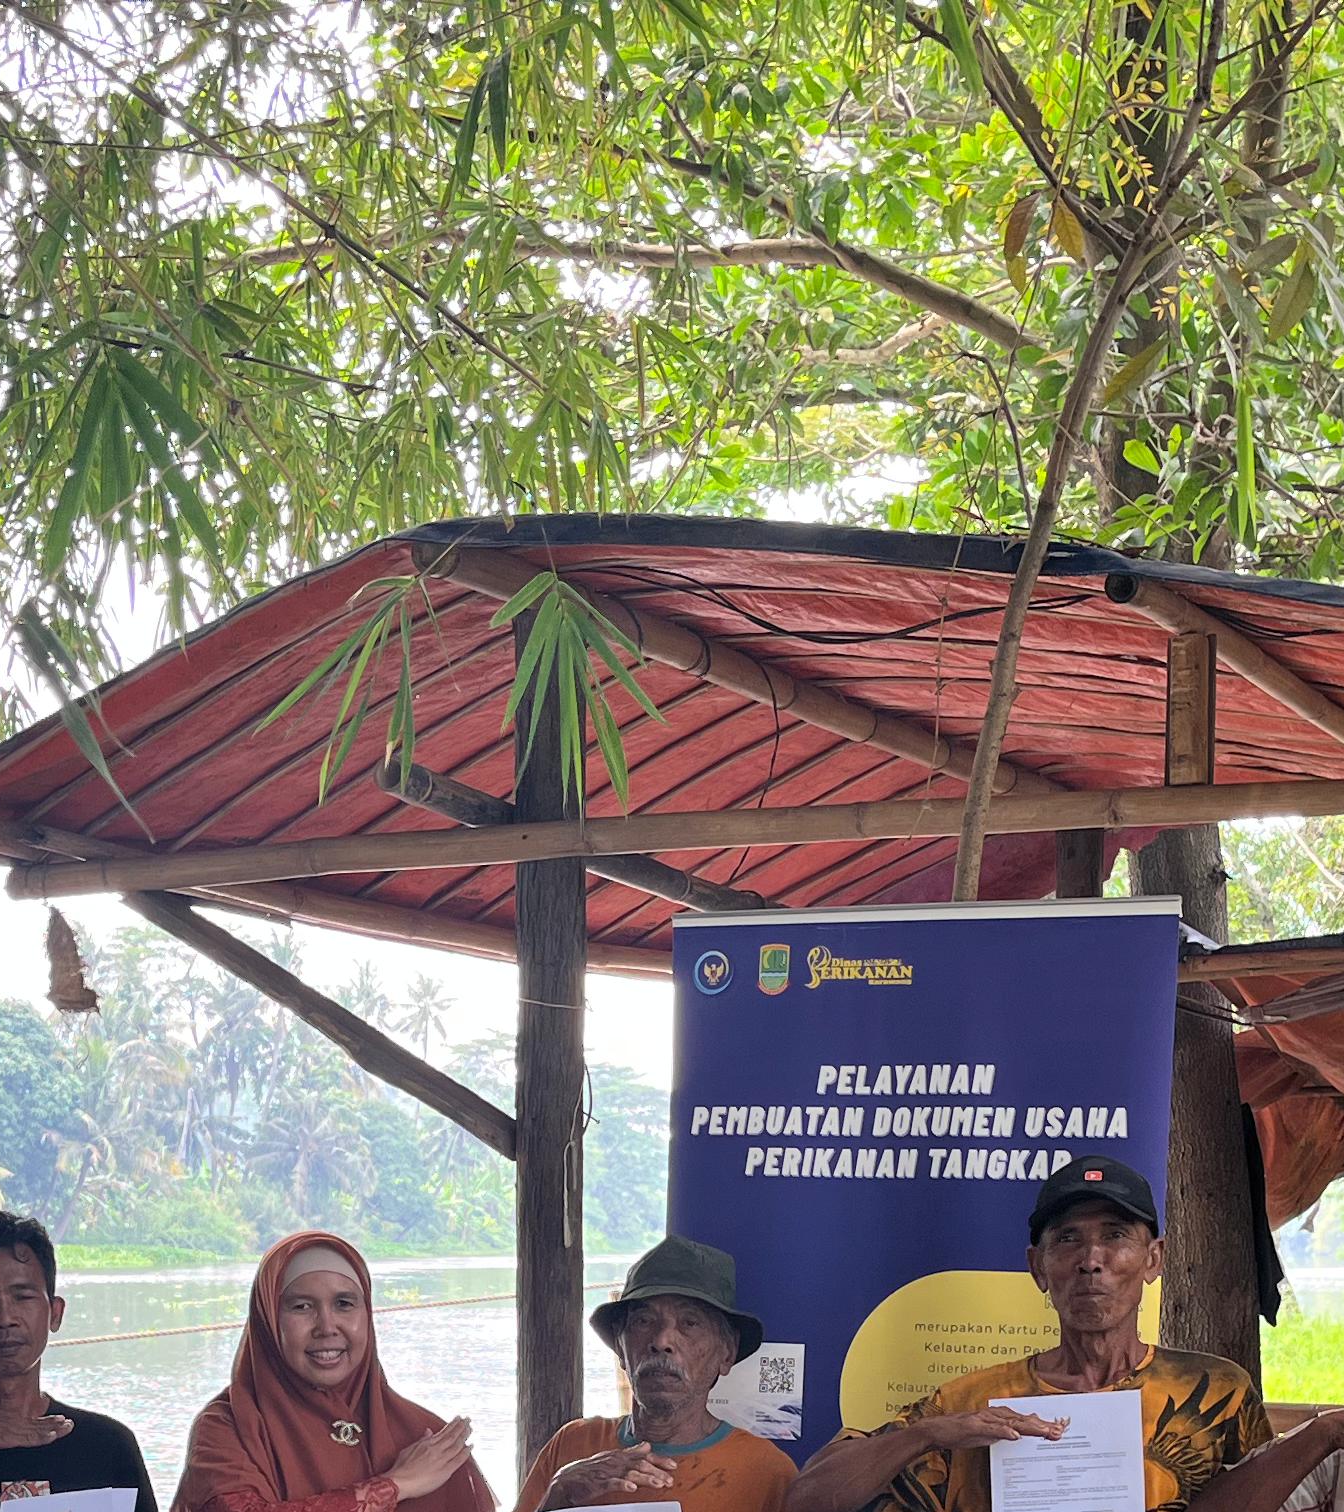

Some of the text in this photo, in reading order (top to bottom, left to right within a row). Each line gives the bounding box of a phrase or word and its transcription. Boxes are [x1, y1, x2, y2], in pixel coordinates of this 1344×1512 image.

[816, 1064, 996, 1095] PELAYANAN
[690, 1106, 1129, 1139] PEMBUATAN DOKUMEN USAHA
[744, 1147, 919, 1179] PERIKANAN
[914, 1322, 993, 1337] merupakan
[998, 1323, 1038, 1336] Kartu
[924, 1342, 986, 1355] Kelautan
[990, 1343, 1018, 1356] dan
[887, 1381, 938, 1393] Kelauta
